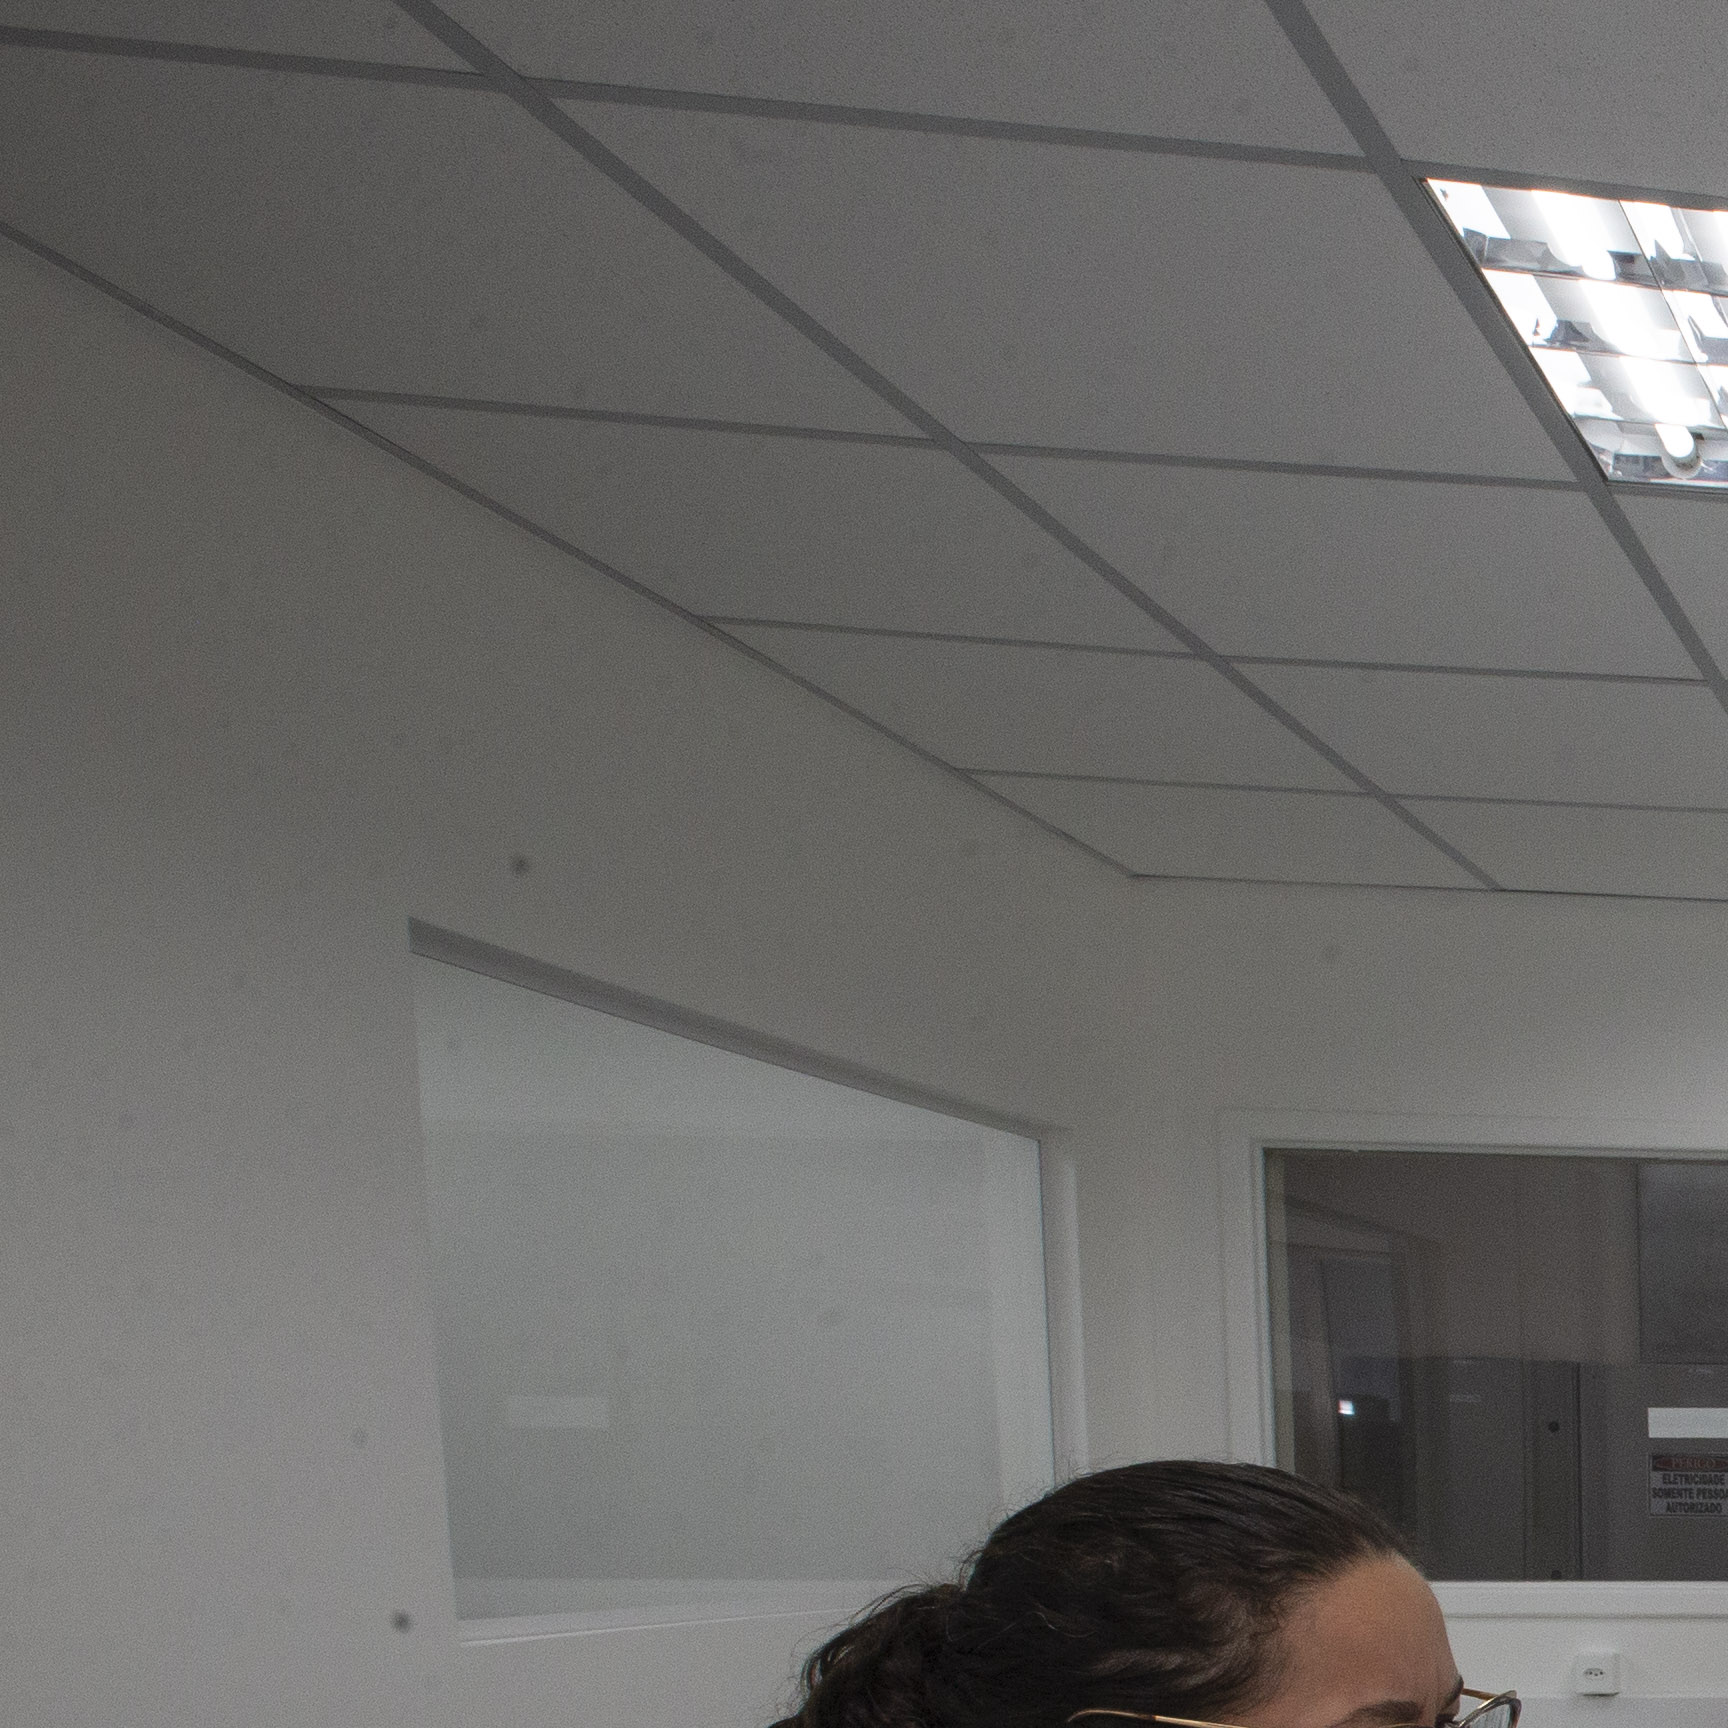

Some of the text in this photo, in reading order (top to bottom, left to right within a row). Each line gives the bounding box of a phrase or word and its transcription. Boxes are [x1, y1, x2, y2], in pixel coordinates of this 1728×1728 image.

[1671, 1456, 1716, 1469] PERIGO
[1662, 1473, 1725, 1485] ELETRICIDADE
[1652, 1488, 1694, 1500] SOMENTE
[1665, 1502, 1722, 1514] AUTORIZADO
